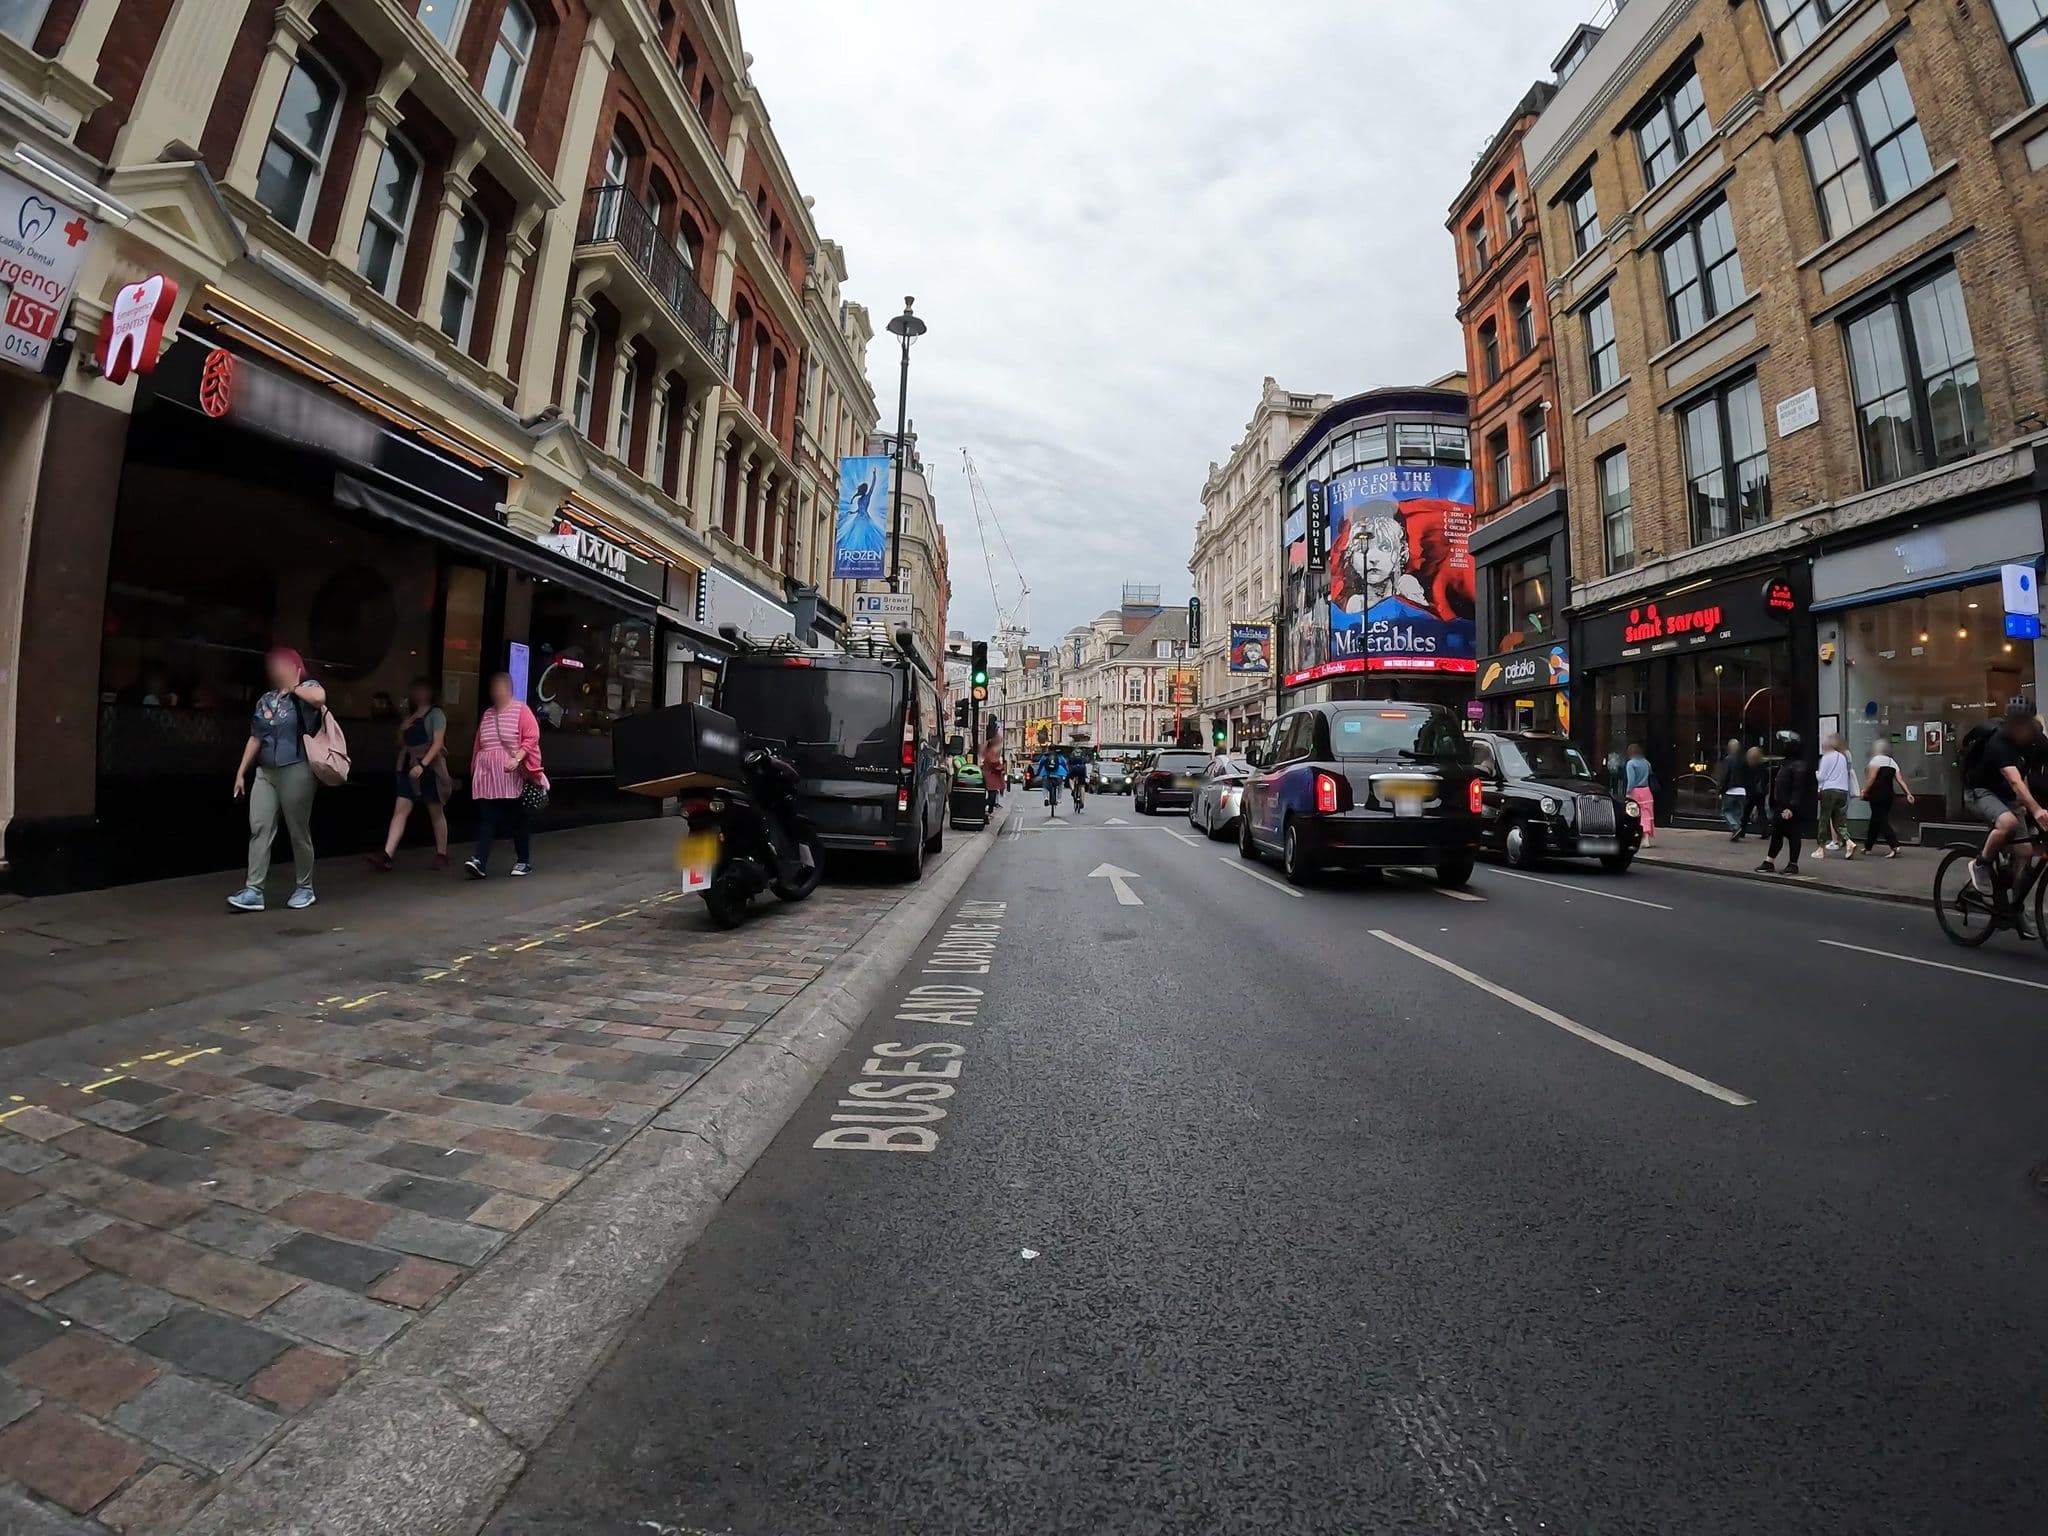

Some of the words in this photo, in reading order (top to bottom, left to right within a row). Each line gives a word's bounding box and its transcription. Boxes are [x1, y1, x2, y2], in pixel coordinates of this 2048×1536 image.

[27, 246, 56, 267] Dental
[115, 314, 150, 335] DENTIST
[4, 334, 40, 358] 0154
[1333, 483, 1346, 495] LES
[1348, 476, 1368, 487] MIS
[1373, 472, 1397, 484] FOR
[1404, 471, 1431, 482] THE
[1333, 489, 1354, 505] 21ST
[1360, 480, 1432, 497] CENTURY
[1311, 493, 1321, 565] SONDHEIM
[1361, 614, 1389, 633] Les
[956, 900, 1008, 919] ONLY
[921, 923, 1004, 974] LOADING
[894, 984, 985, 1026] AND
[812, 1042, 967, 1152] BUSES
